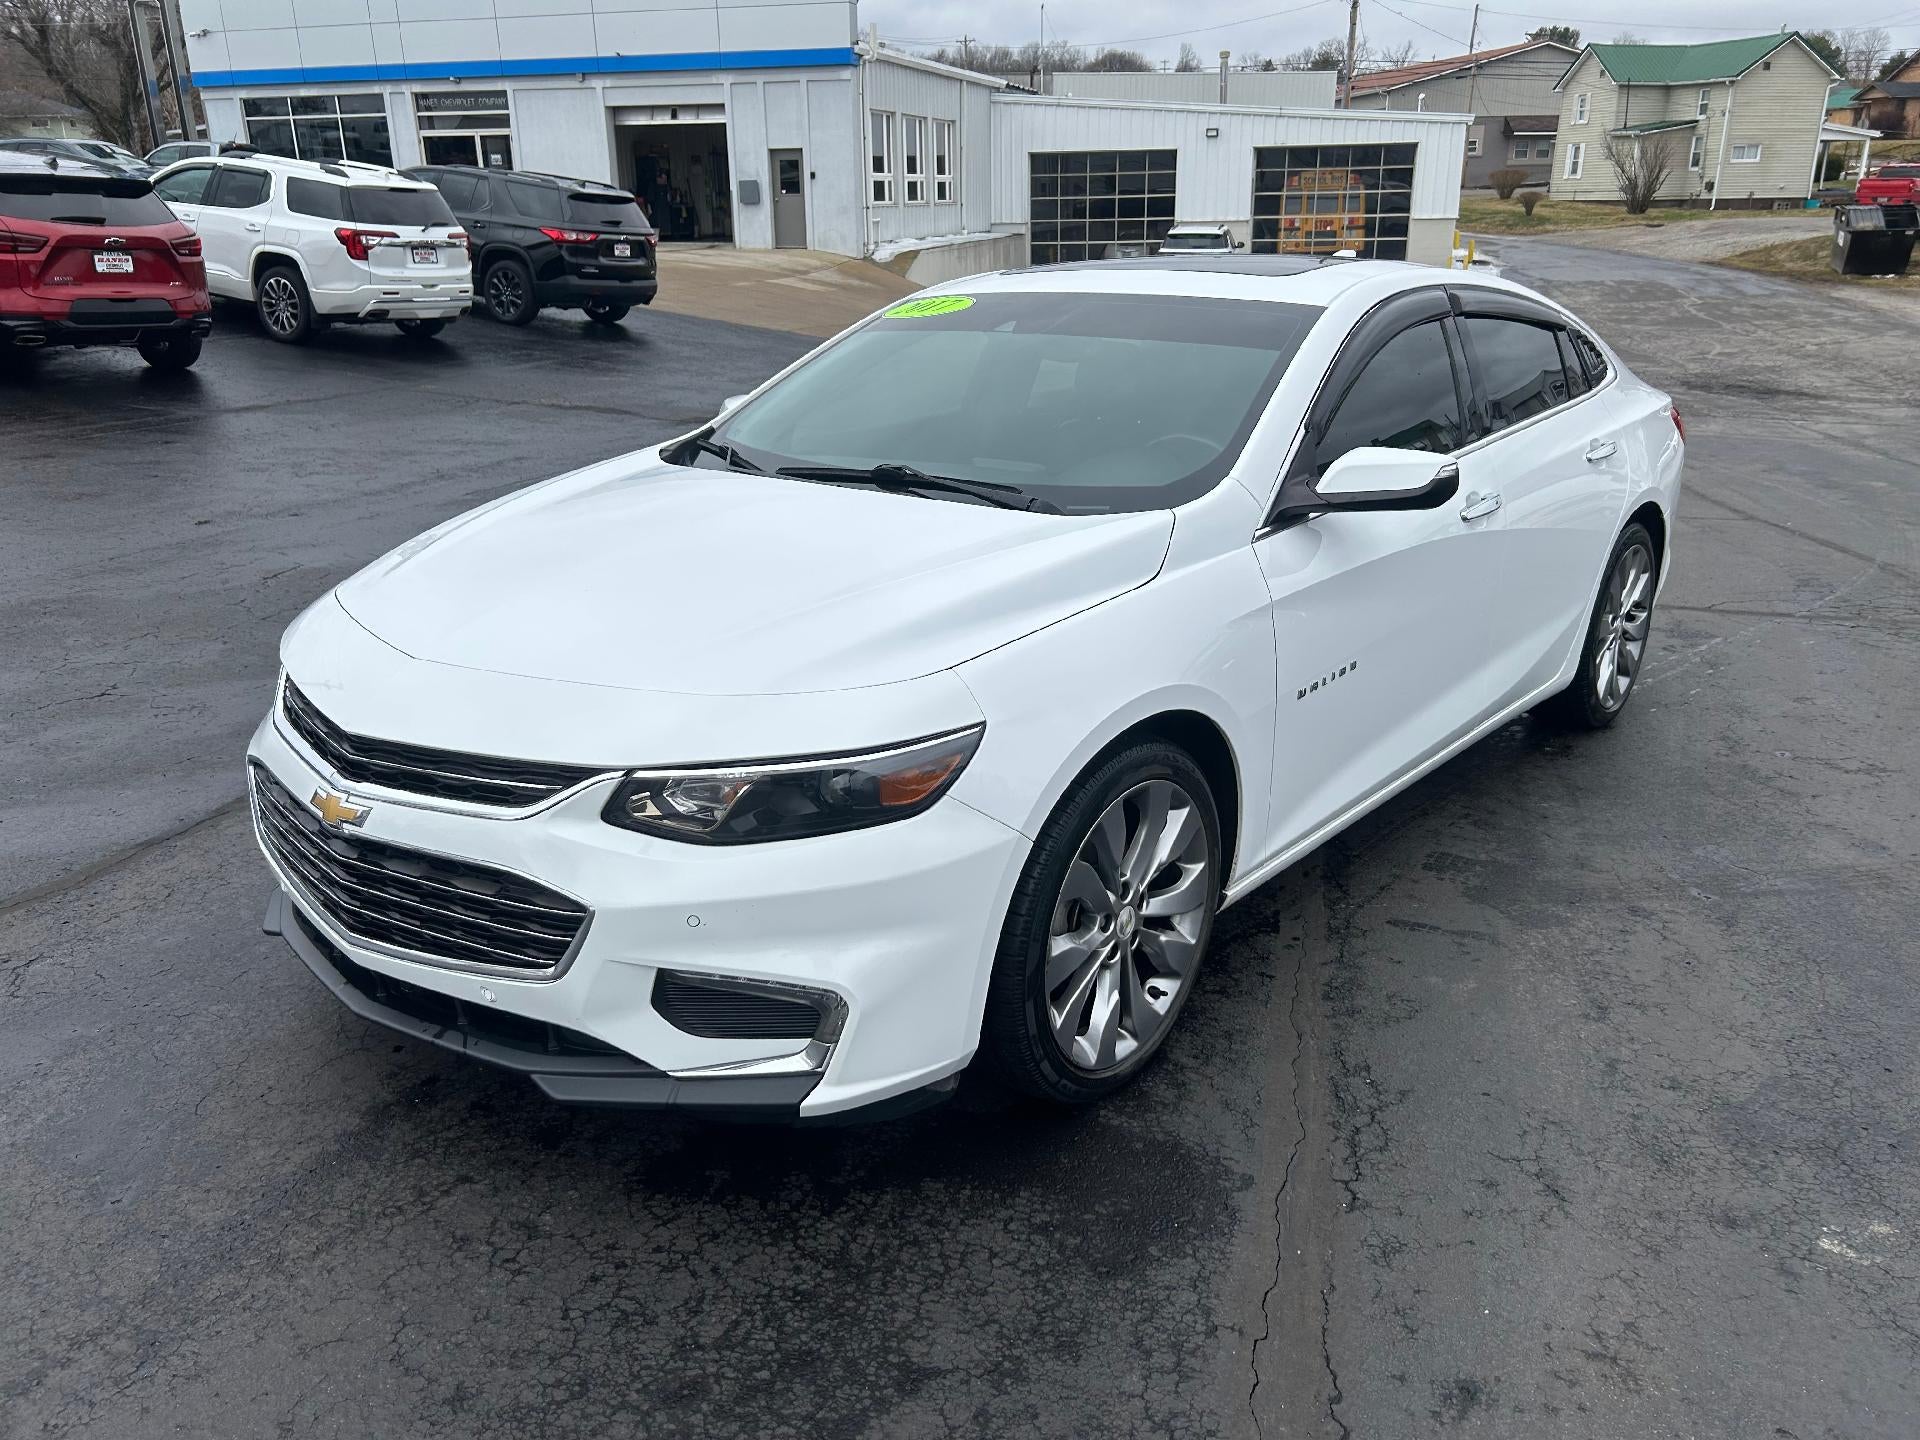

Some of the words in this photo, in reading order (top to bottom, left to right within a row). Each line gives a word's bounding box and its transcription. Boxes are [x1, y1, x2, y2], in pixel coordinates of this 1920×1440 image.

[441, 98, 476, 107] CHEVROLET
[479, 97, 507, 106] COMPANY
[1304, 175, 1328, 185] SCHOL
[1315, 219, 1334, 230] STOP
[1297, 660, 1357, 700] MALIBU
